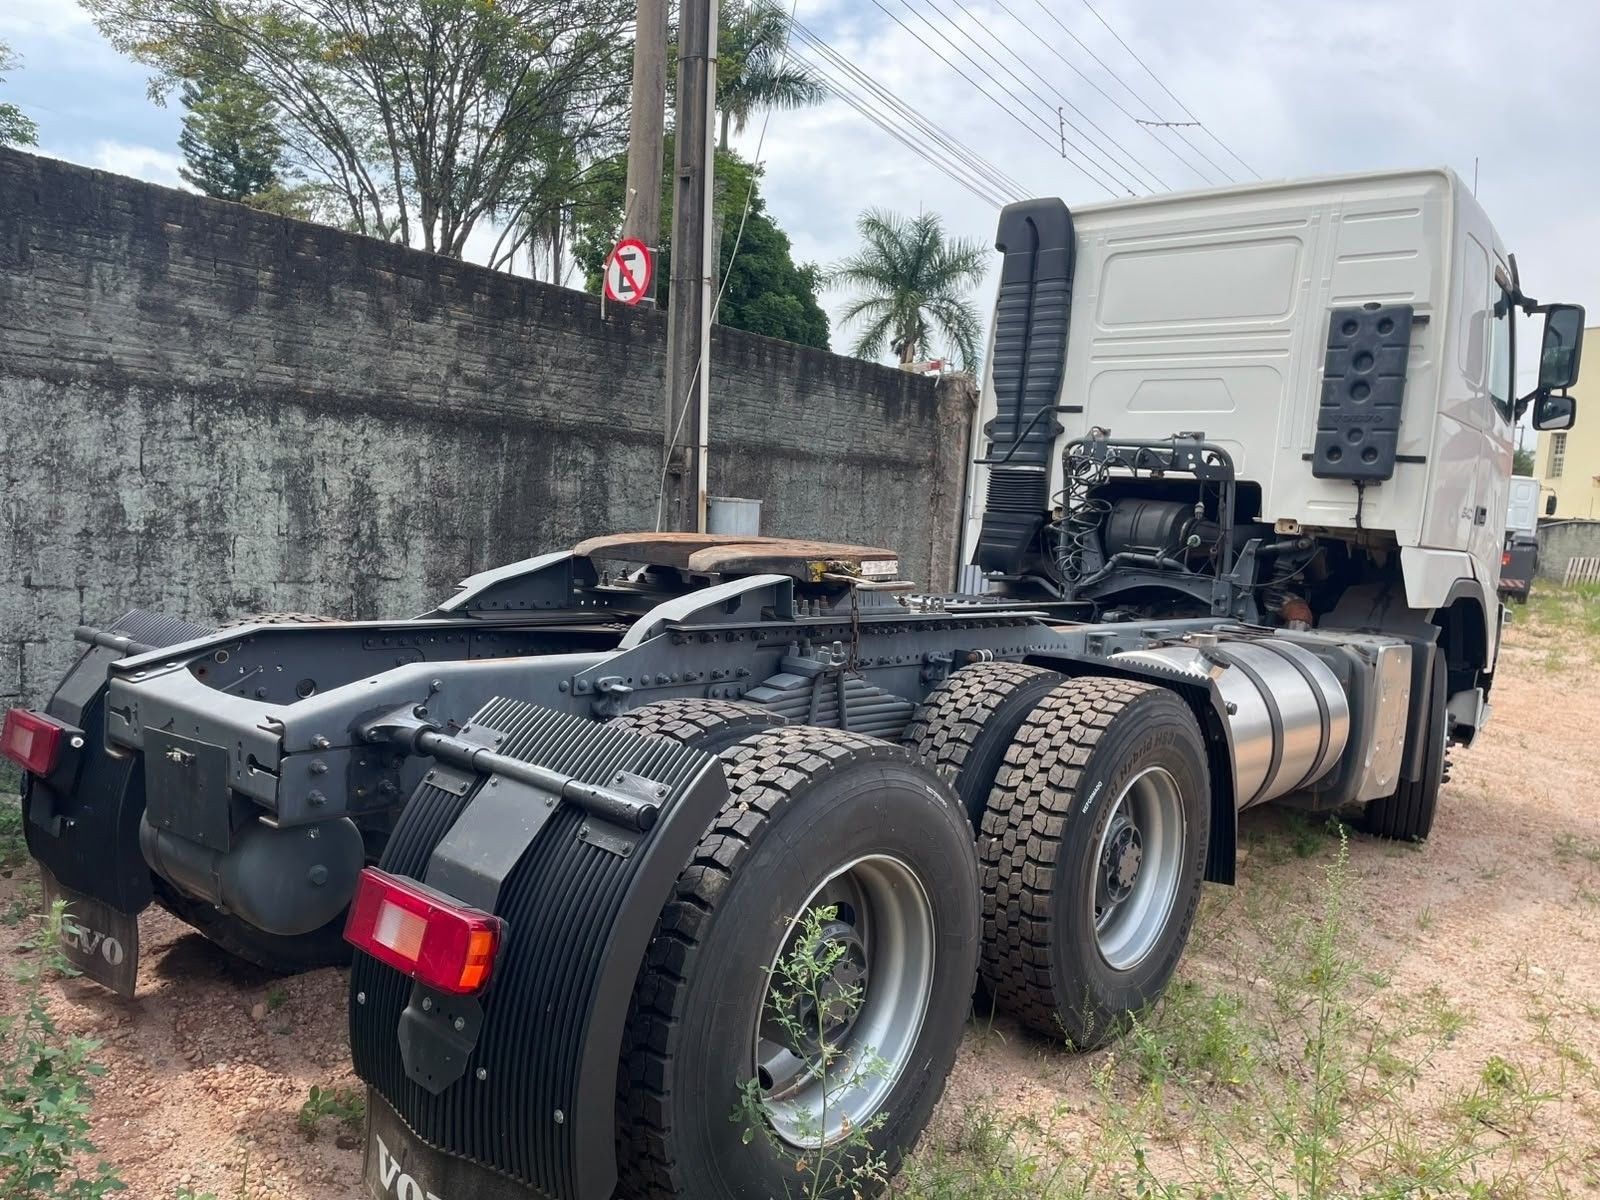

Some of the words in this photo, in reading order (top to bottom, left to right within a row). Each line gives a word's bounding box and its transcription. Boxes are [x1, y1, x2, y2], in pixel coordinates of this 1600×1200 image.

[618, 253, 636, 293] E
[1082, 781, 1102, 814] REFORMADO
[376, 1134, 442, 1200] VO
